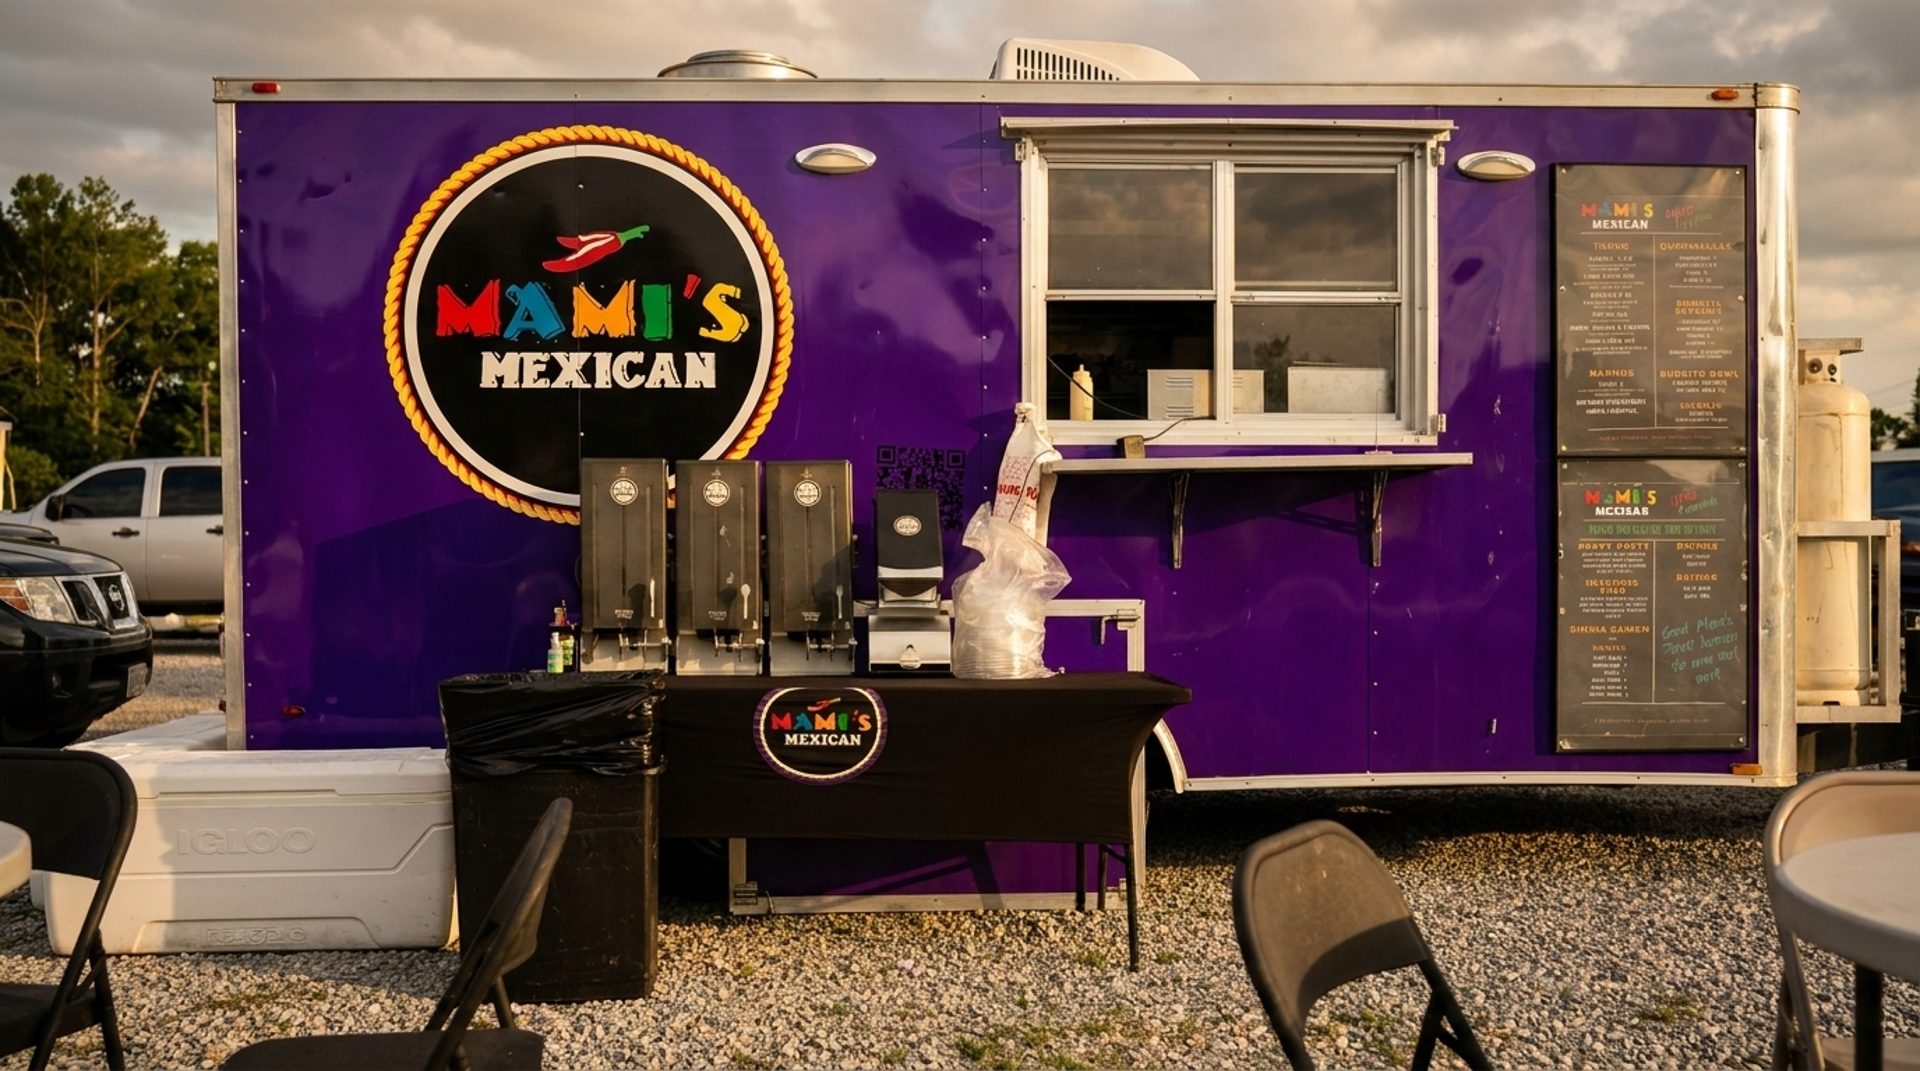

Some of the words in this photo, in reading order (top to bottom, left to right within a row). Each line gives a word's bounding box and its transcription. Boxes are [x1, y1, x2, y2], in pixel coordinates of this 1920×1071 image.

[436, 273, 750, 343] MAMI'S
[479, 350, 717, 389] MEXICAN
[770, 710, 872, 732] MAMI'S
[784, 733, 862, 746] MEXICAN
[177, 827, 316, 856] IGLOO
